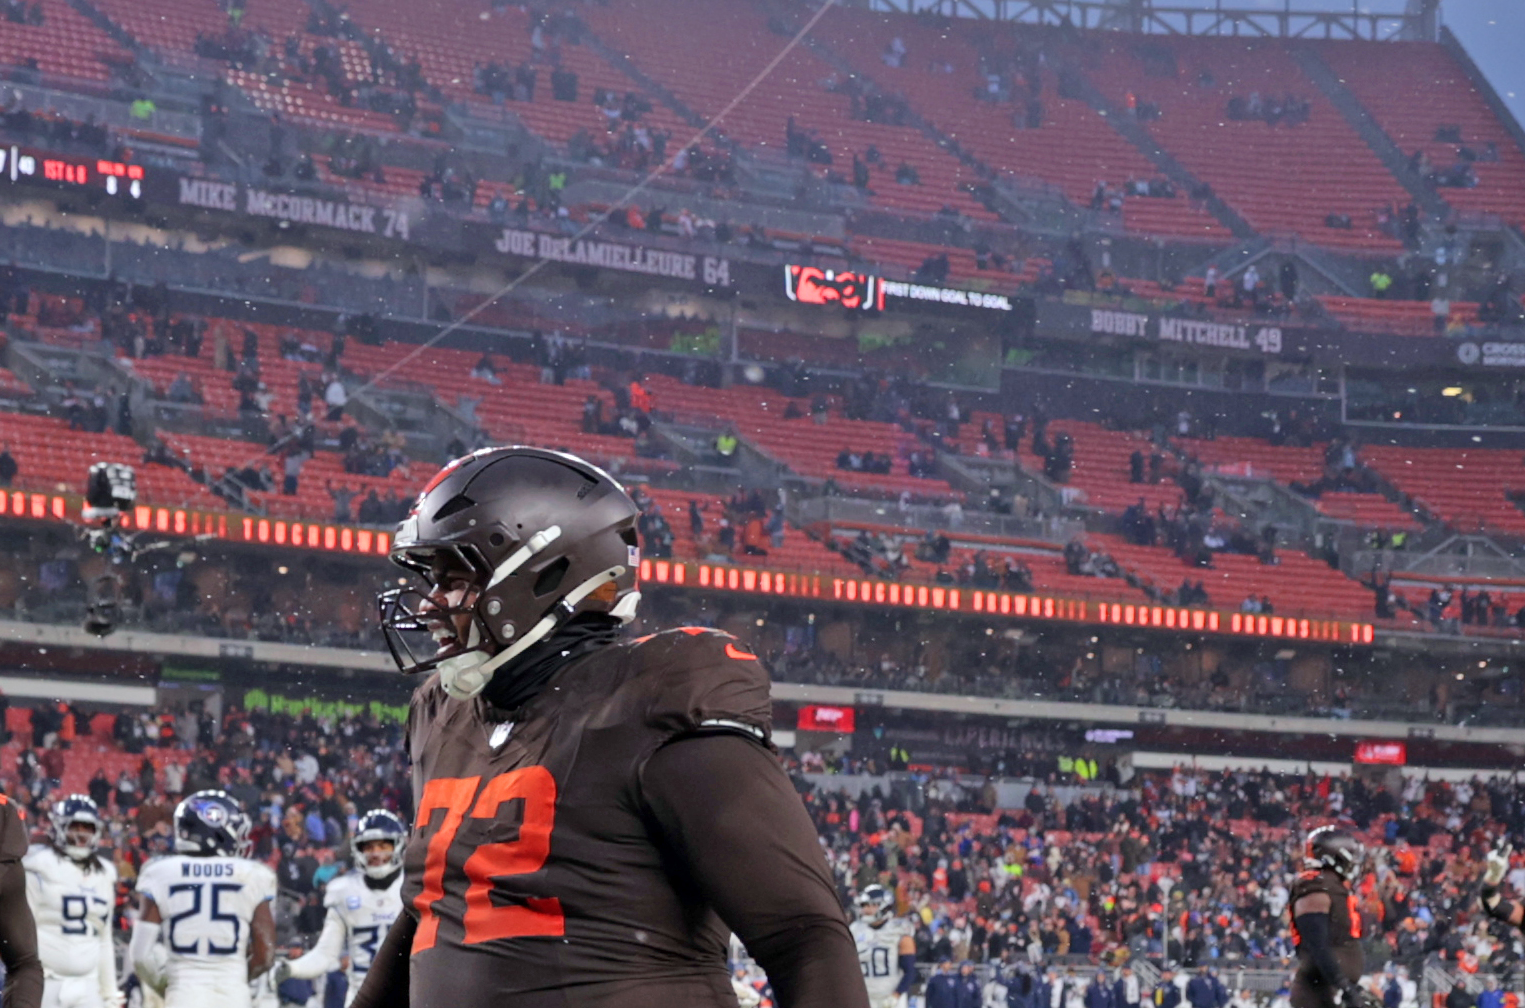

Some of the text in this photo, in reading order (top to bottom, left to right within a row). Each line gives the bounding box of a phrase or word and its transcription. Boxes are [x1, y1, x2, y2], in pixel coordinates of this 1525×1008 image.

[180, 177, 410, 242] MIKE McCORMACK 74
[495, 228, 731, 287] JOE DeLAMIELLEURE 64
[881, 280, 909, 298] FIRST
[909, 284, 940, 301] DOWN
[940, 287, 968, 306] GOAL
[968, 291, 983, 307] TO
[1091, 308, 1283, 354] BOBBY MITCHELL 49
[243, 517, 390, 556] TOUCHDOWN
[833, 578, 960, 610] TOUCHDOWN
[1099, 602, 1221, 632] TOUCHDOWN
[181, 862, 235, 878] WOODS
[410, 764, 566, 956] 72
[169, 882, 246, 955] 25
[352, 924, 395, 972] 3
